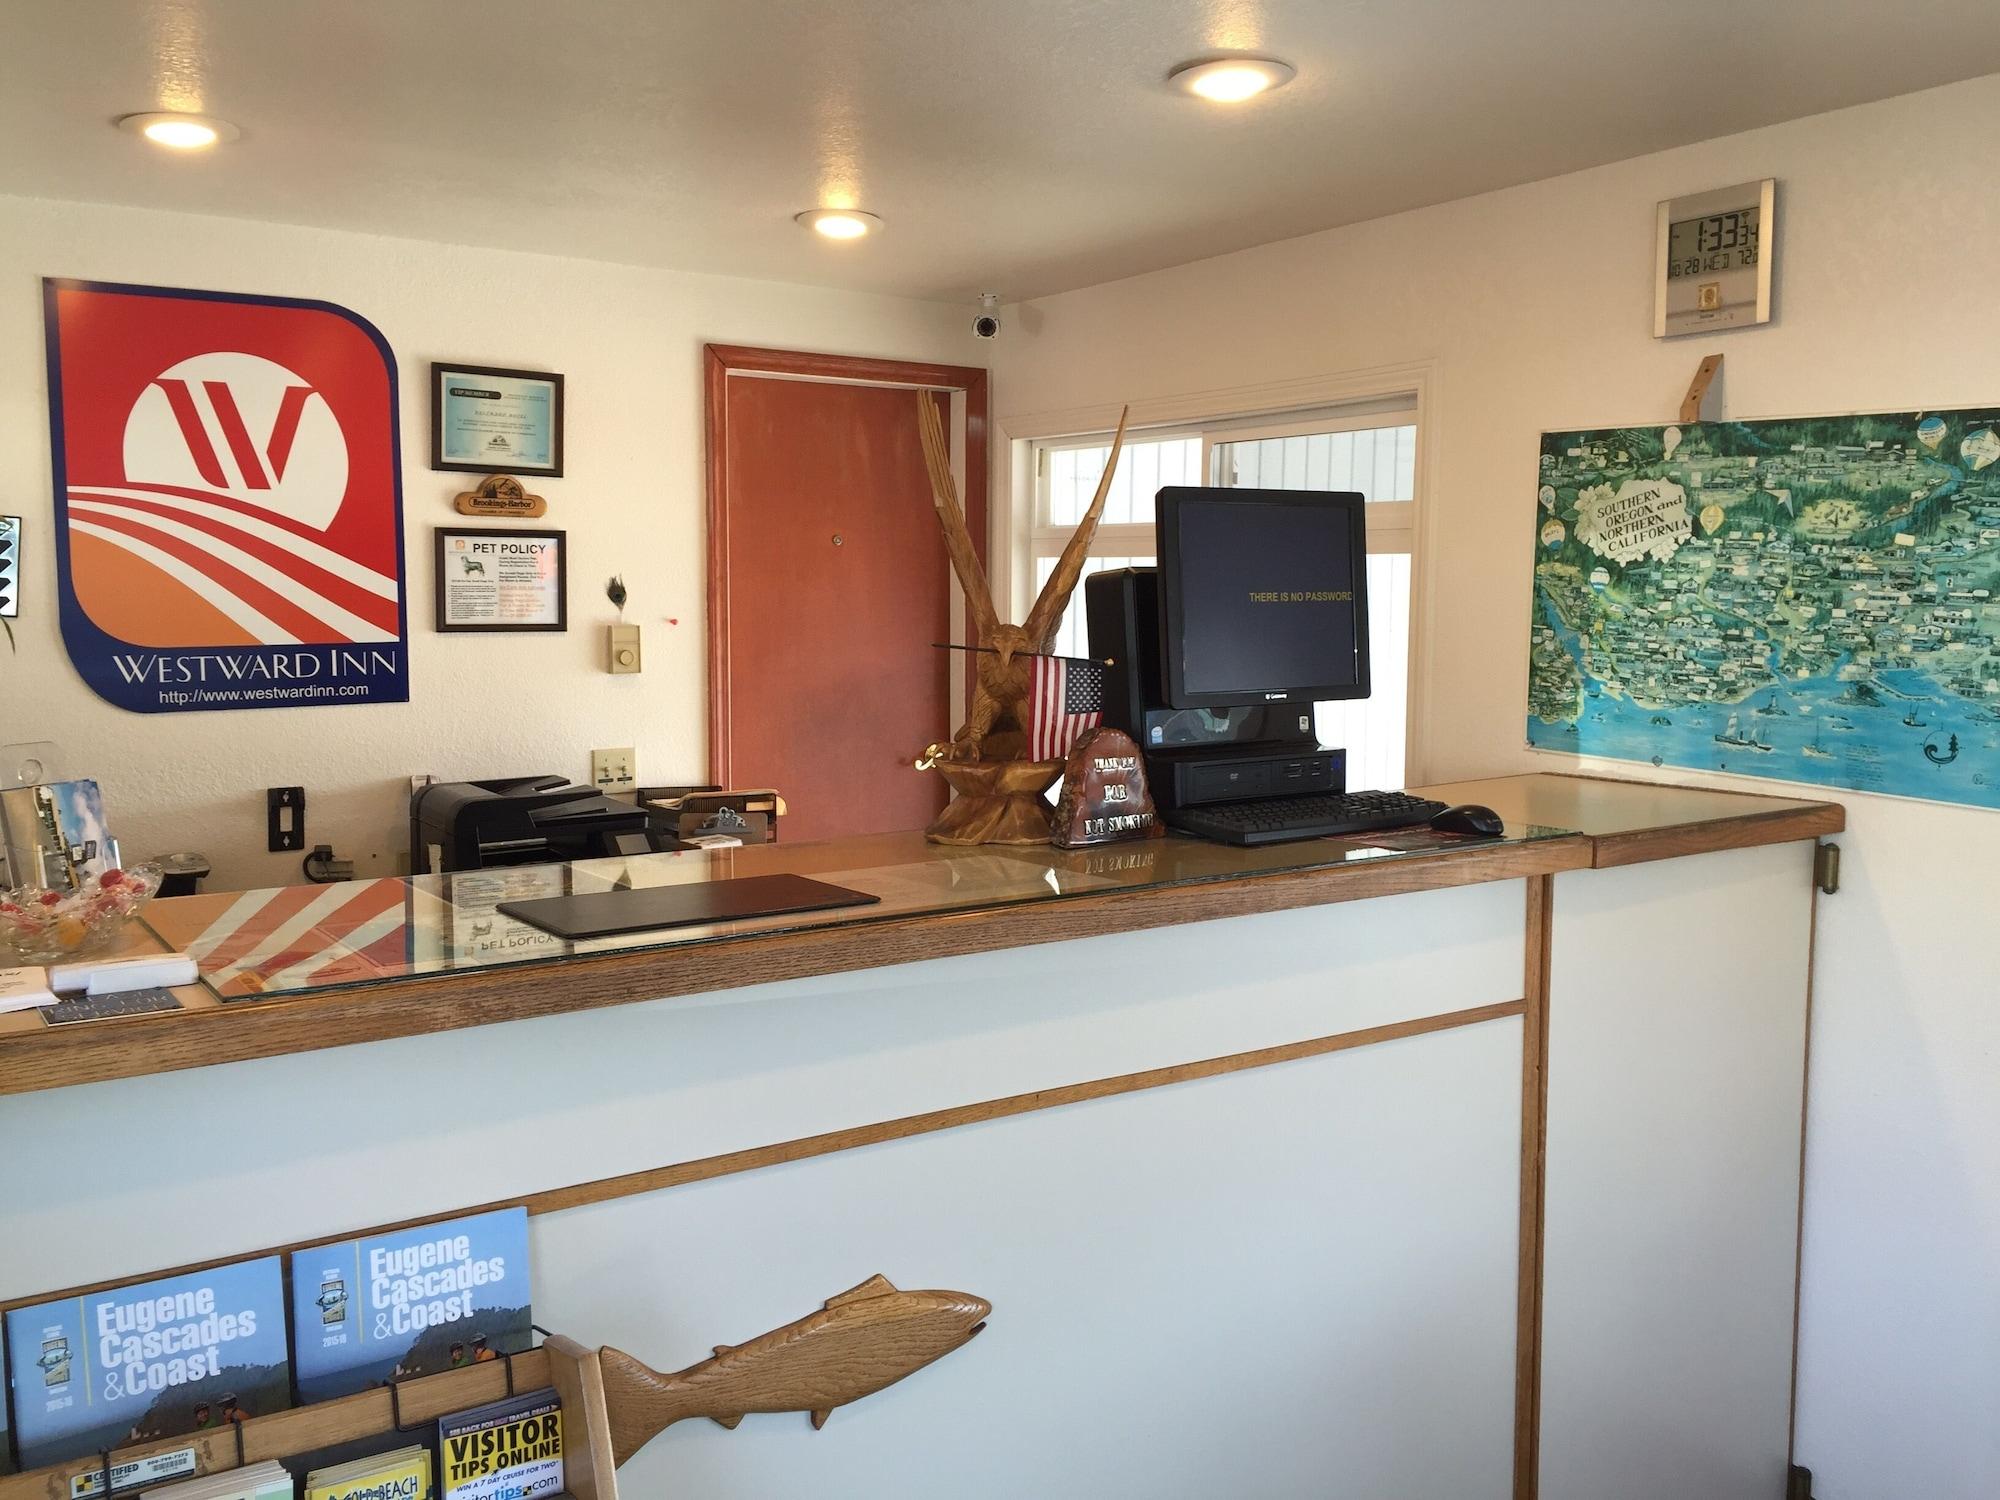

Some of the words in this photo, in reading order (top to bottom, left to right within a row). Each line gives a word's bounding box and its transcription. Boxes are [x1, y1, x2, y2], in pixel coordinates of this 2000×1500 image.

[1684, 258, 1699, 275] 28
[1703, 253, 1730, 271] WED
[473, 498, 532, 508] Brookings-Harbor
[1597, 487, 1662, 519] SOUTHERN
[1605, 504, 1654, 528] OREGON
[1656, 495, 1683, 511] and
[1599, 512, 1665, 542] NORTHERN
[1608, 519, 1690, 552] CALIFORNIA
[473, 543, 497, 554] PET
[501, 544, 547, 554] POLICY
[1249, 592, 1279, 602] THERE
[1280, 592, 1289, 602] IS
[1290, 592, 1304, 602] NO
[112, 652, 320, 684] WESTWARD
[330, 649, 397, 678] INN
[159, 683, 369, 706] http://www.westwardinn.com
[1094, 757, 1118, 772] THANK
[1104, 784, 1128, 802] FOR
[1084, 818, 1105, 837] NOT
[370, 1235, 470, 1280] Eugene
[372, 1257, 505, 1310] Cascades
[97, 1287, 215, 1338] Eugene
[99, 1310, 257, 1369] Cascades
[450, 1414, 558, 1463] VISITOR
[93, 1463, 139, 1481] CETIFIED
[451, 1457, 490, 1481] TIPS
[496, 1437, 560, 1469] ONLINE
[378, 1475, 418, 1500] BEACH
[456, 1484, 472, 1493] WIN
[480, 1479, 486, 1488] 7
[487, 1476, 500, 1485] DAY
[502, 1469, 525, 1481] CRUISE
[526, 1466, 540, 1476] FOR
